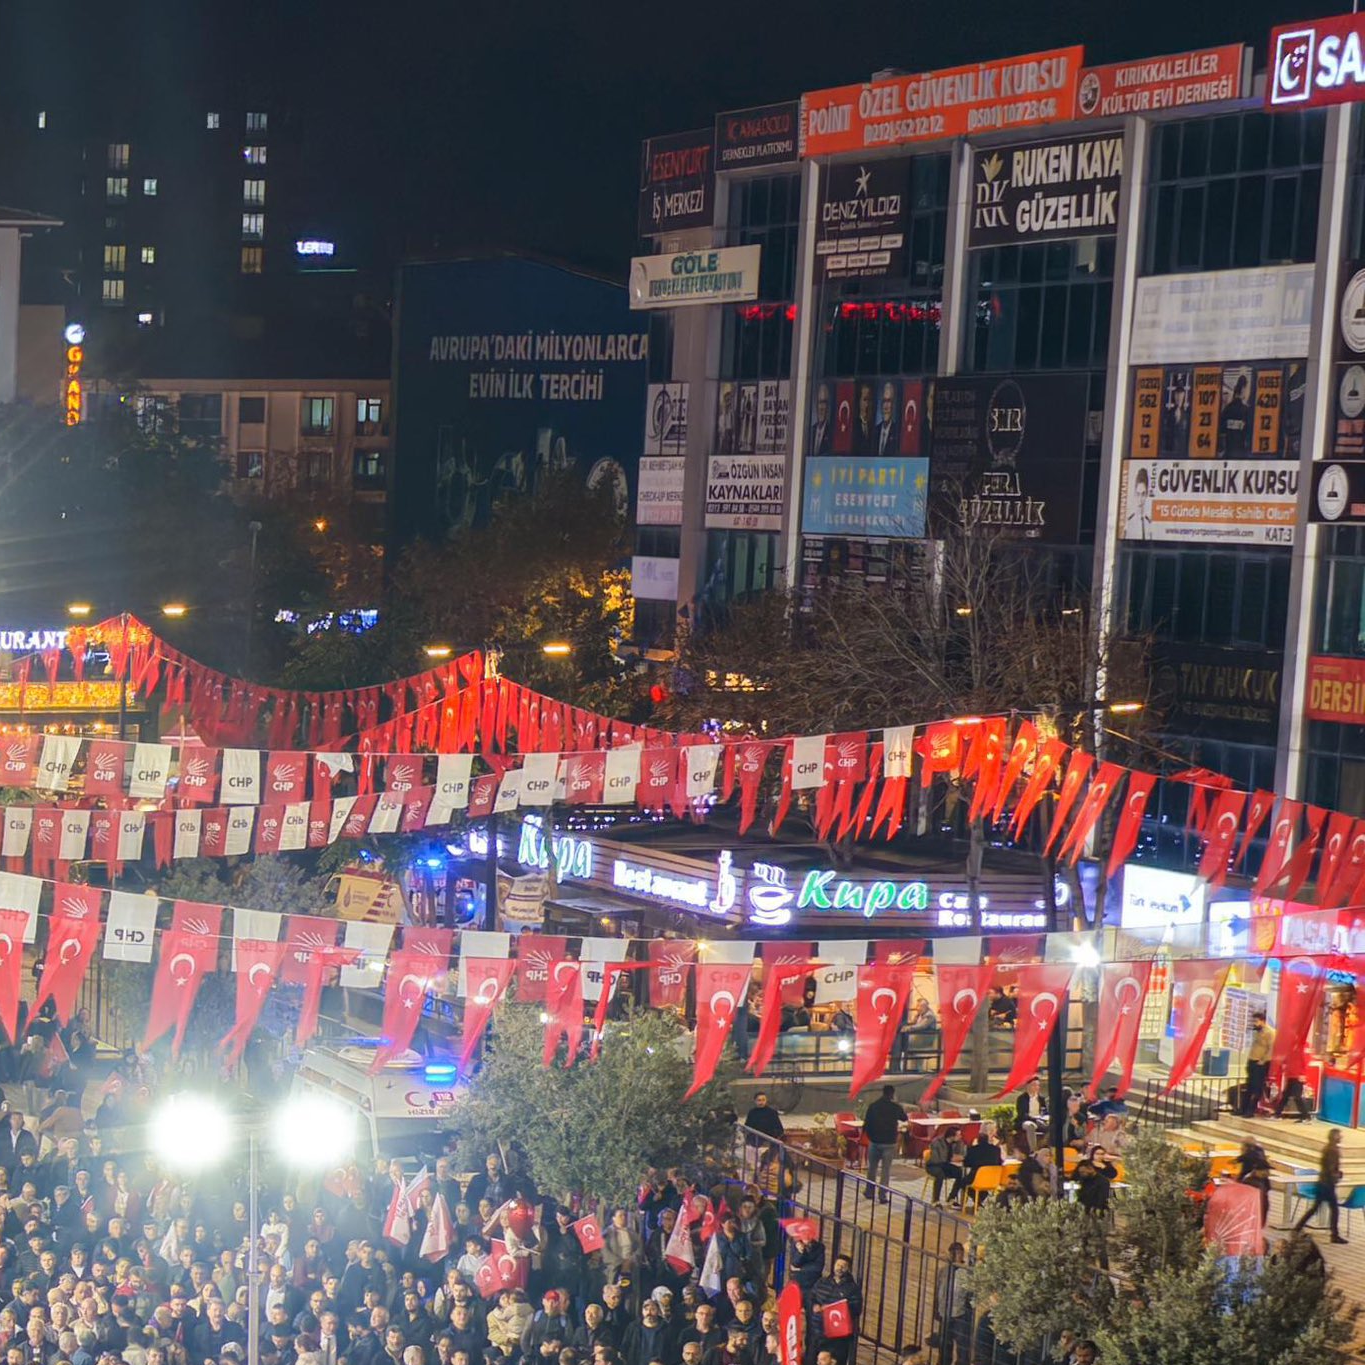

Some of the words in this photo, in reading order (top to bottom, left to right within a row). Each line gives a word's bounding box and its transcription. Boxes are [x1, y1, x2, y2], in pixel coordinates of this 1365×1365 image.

[1115, 53, 1218, 88] KIRIKKALELİLER
[859, 84, 901, 119] ÖZEL
[905, 64, 998, 113] GÜVENLİK
[1000, 56, 1068, 97] KURSU
[1101, 87, 1149, 116] KÜLTÜR
[1152, 83, 1173, 109] EVİ
[1175, 74, 1233, 105] DERNEĞİ
[653, 146, 709, 181] ESENYURT
[1011, 146, 1073, 187] RUKEN
[1077, 138, 1123, 180] KAYA
[664, 185, 703, 217] MERKEZİ
[1015, 184, 1117, 233] GÜZELLİK
[671, 252, 719, 275] GÖLE
[430, 330, 533, 361] AVRUPA'DAKİ
[535, 330, 648, 361] MİLYONLARCA
[470, 368, 507, 398] EVİN
[509, 368, 533, 399] İLK
[540, 369, 604, 400] TERCİHİ
[731, 460, 760, 479] ÖZGÜN
[1158, 463, 1238, 495] GÜVENLİK
[1243, 469, 1299, 495] KURSU
[708, 485, 782, 500] KAYNAKLARI
[138, 770, 161, 781] CHP
[229, 777, 253, 787] CHP
[798, 763, 818, 774] CHP
[391, 781, 412, 791] CHP
[797, 869, 929, 917] Kupa
[825, 970, 854, 985] CHP
